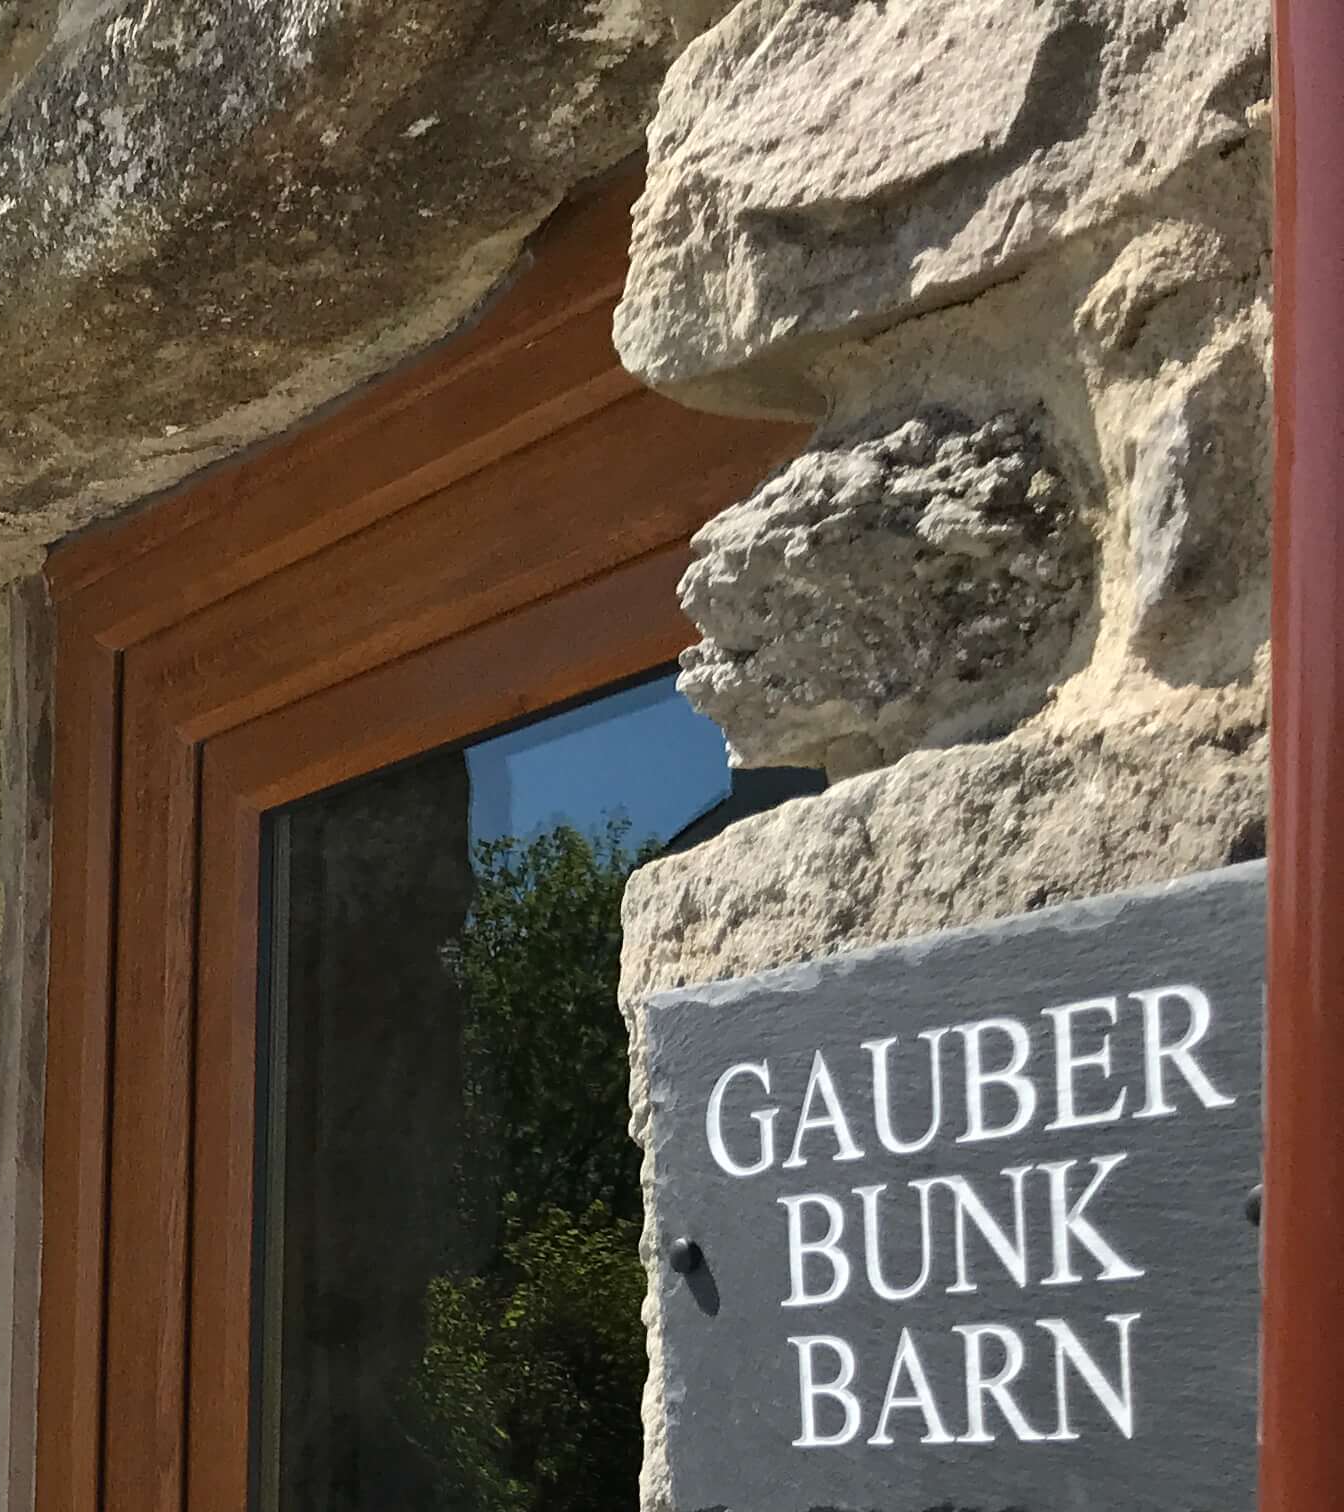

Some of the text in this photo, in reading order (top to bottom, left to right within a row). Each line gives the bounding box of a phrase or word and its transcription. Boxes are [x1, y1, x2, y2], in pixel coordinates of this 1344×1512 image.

[706, 985, 1236, 1177] GAUBER
[777, 1154, 1145, 1307] BUNK
[787, 1313, 1142, 1447] BARN
